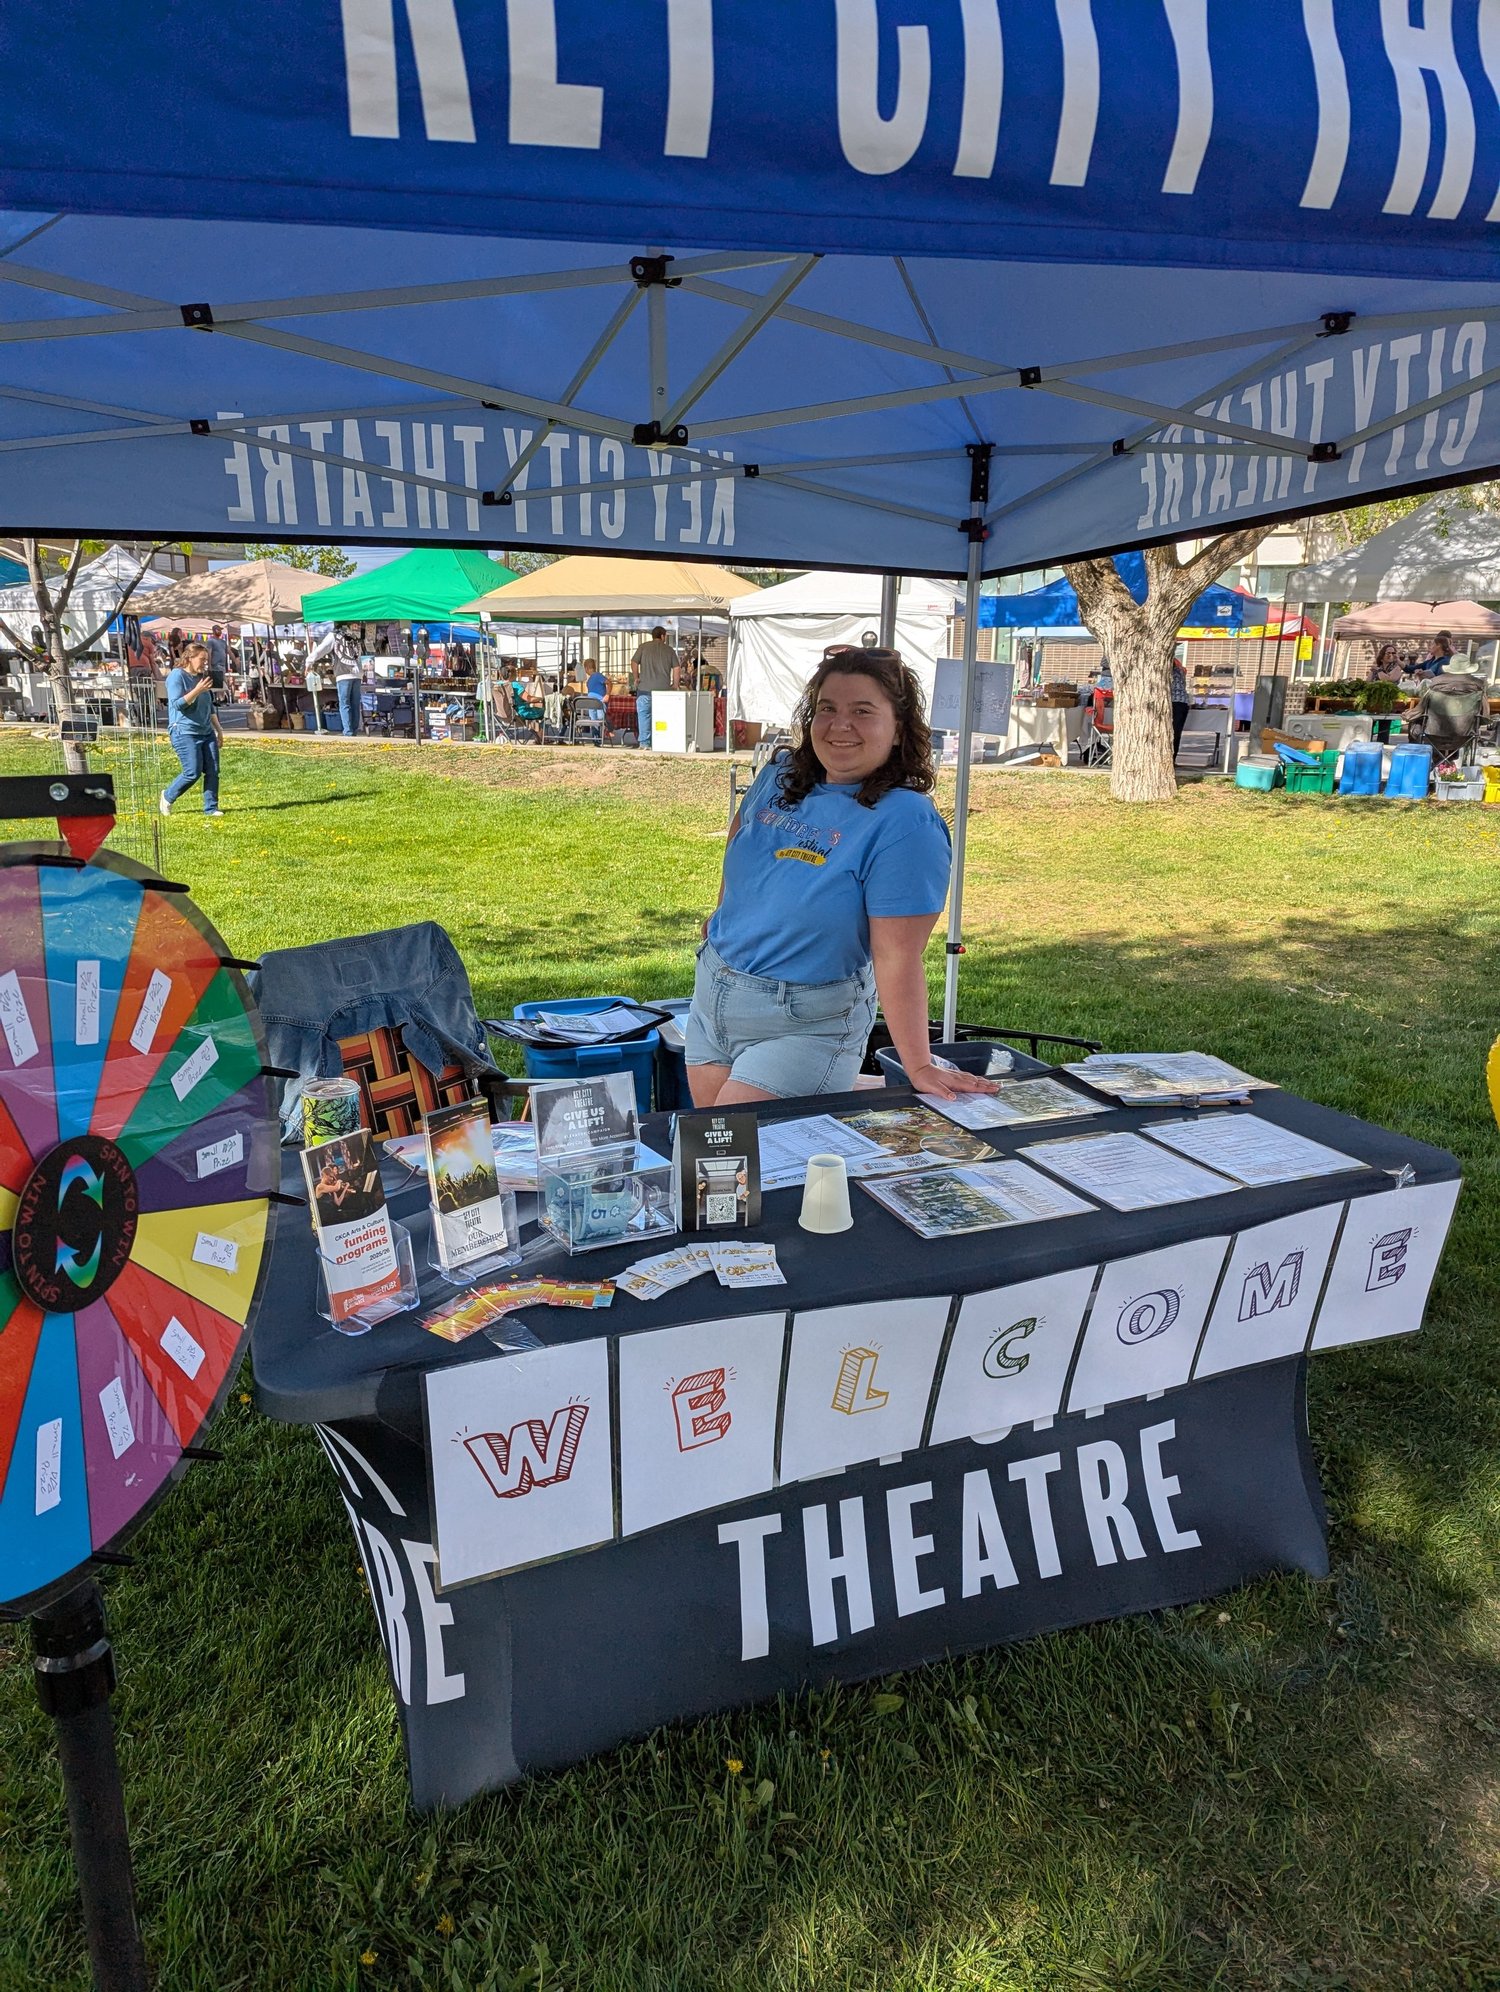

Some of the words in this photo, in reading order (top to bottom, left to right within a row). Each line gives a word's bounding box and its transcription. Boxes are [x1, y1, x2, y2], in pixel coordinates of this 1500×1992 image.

[563, 1109, 589, 1122] GIVE
[590, 1106, 605, 1118] US
[568, 1121, 577, 1131] A
[577, 1115, 605, 1129] LIFT!
[714, 1136, 732, 1144] LIFT!
[100, 1144, 131, 1183] SPIN
[21, 1174, 47, 1226] WIN
[124, 1184, 136, 1212] TO
[351, 1226, 361, 1236] Arts
[366, 1217, 384, 1228] Culture
[591, 1208, 607, 1220] 5
[18, 1233, 33, 1266] TO
[112, 1219, 135, 1266] WIN
[336, 1235, 389, 1265] programs
[344, 1225, 387, 1249] funding
[451, 1230, 505, 1258] MEMBERSHIPS
[25, 1264, 61, 1304] SPIN
[463, 1226, 1413, 1499] WELCOME
[717, 1418, 1203, 1662] THEATRE
